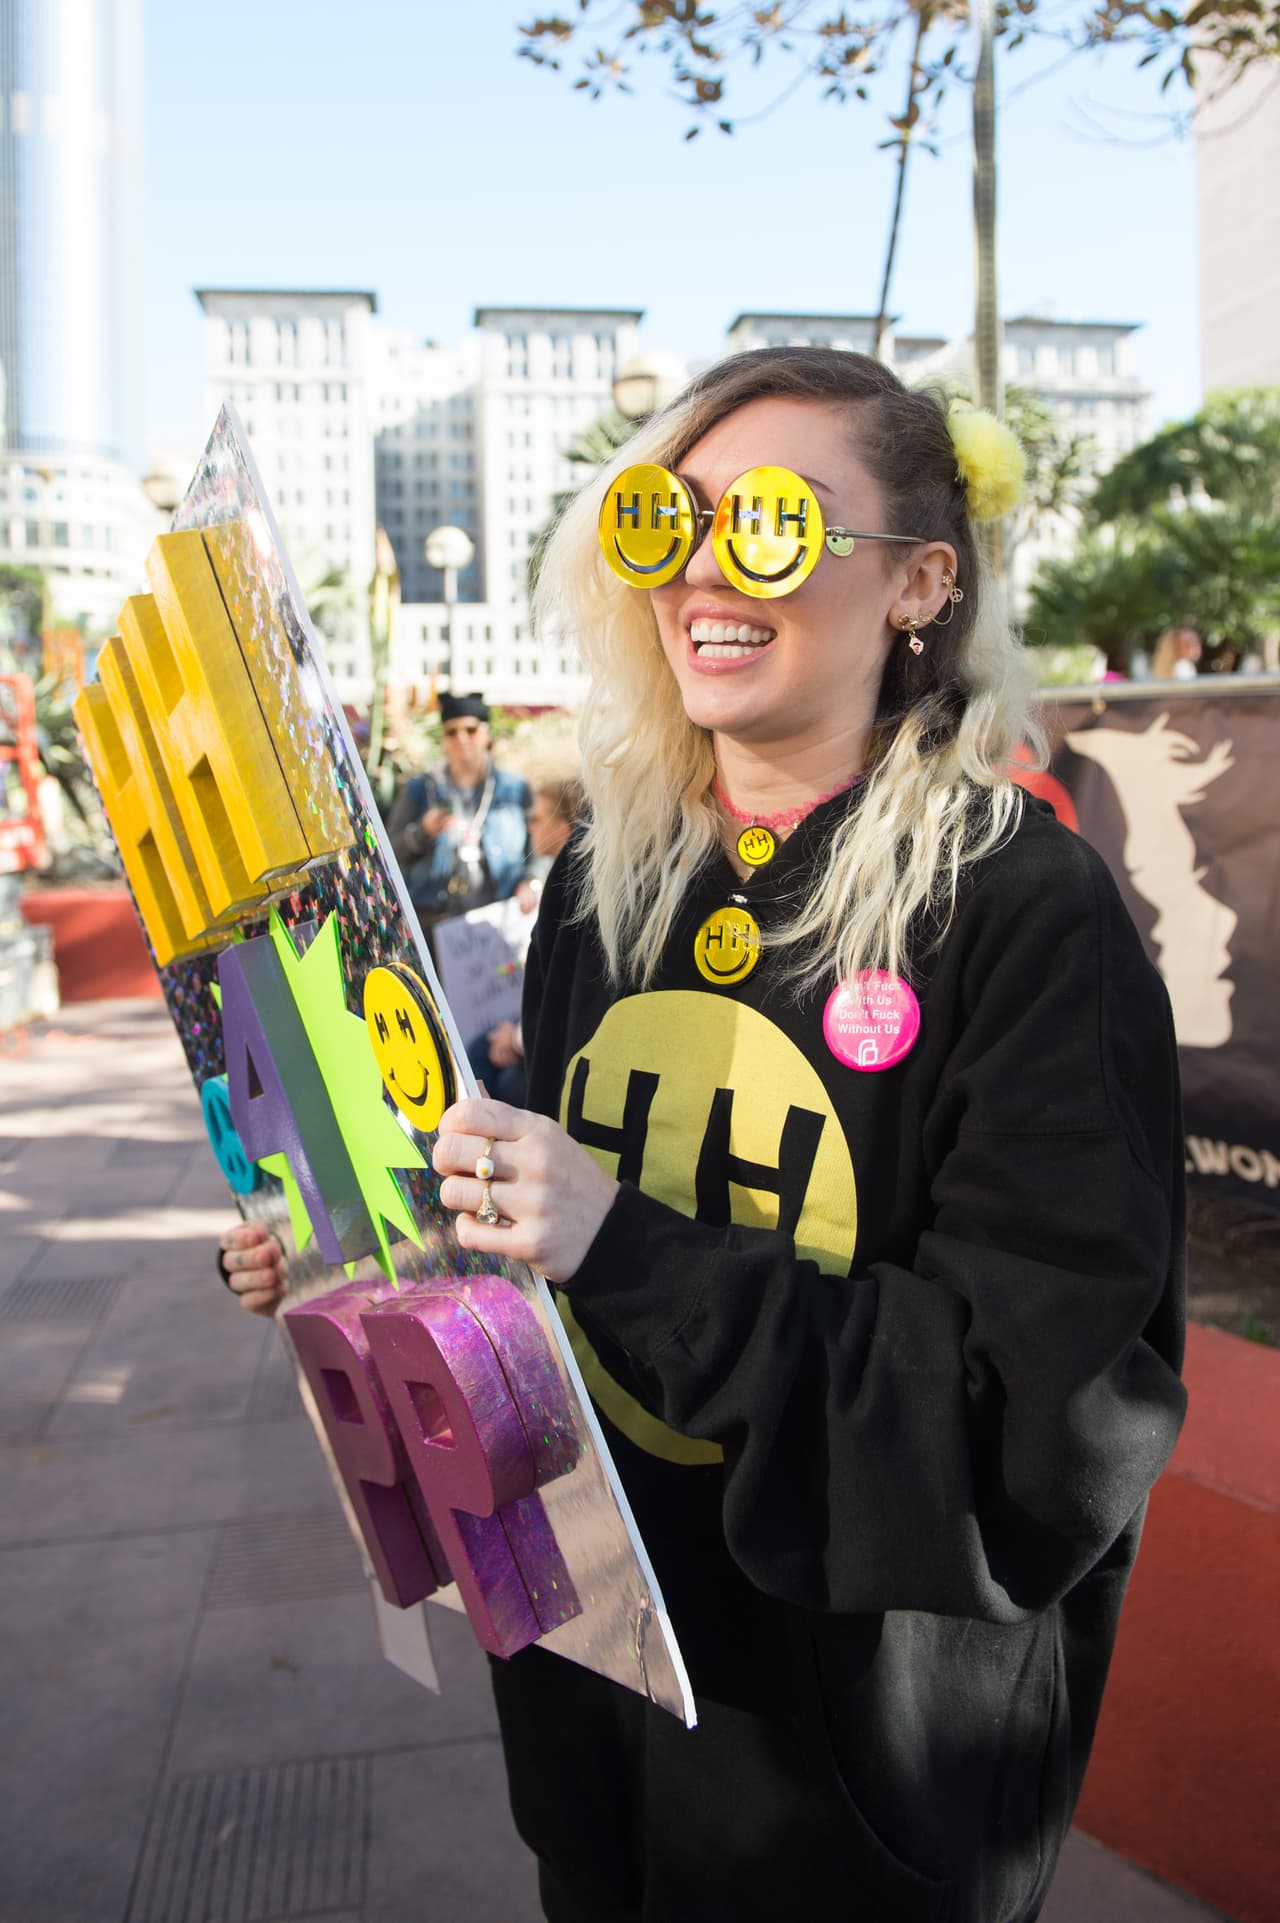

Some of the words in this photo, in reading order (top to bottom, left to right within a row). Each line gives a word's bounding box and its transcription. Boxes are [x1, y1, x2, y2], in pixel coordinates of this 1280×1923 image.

[874, 980, 902, 991] Fuck
[876, 994, 892, 1006] Us
[839, 1009, 870, 1020] Dont
[872, 1009, 900, 1020] Fuck
[837, 1023, 882, 1034] Without
[884, 1023, 900, 1034] Us
